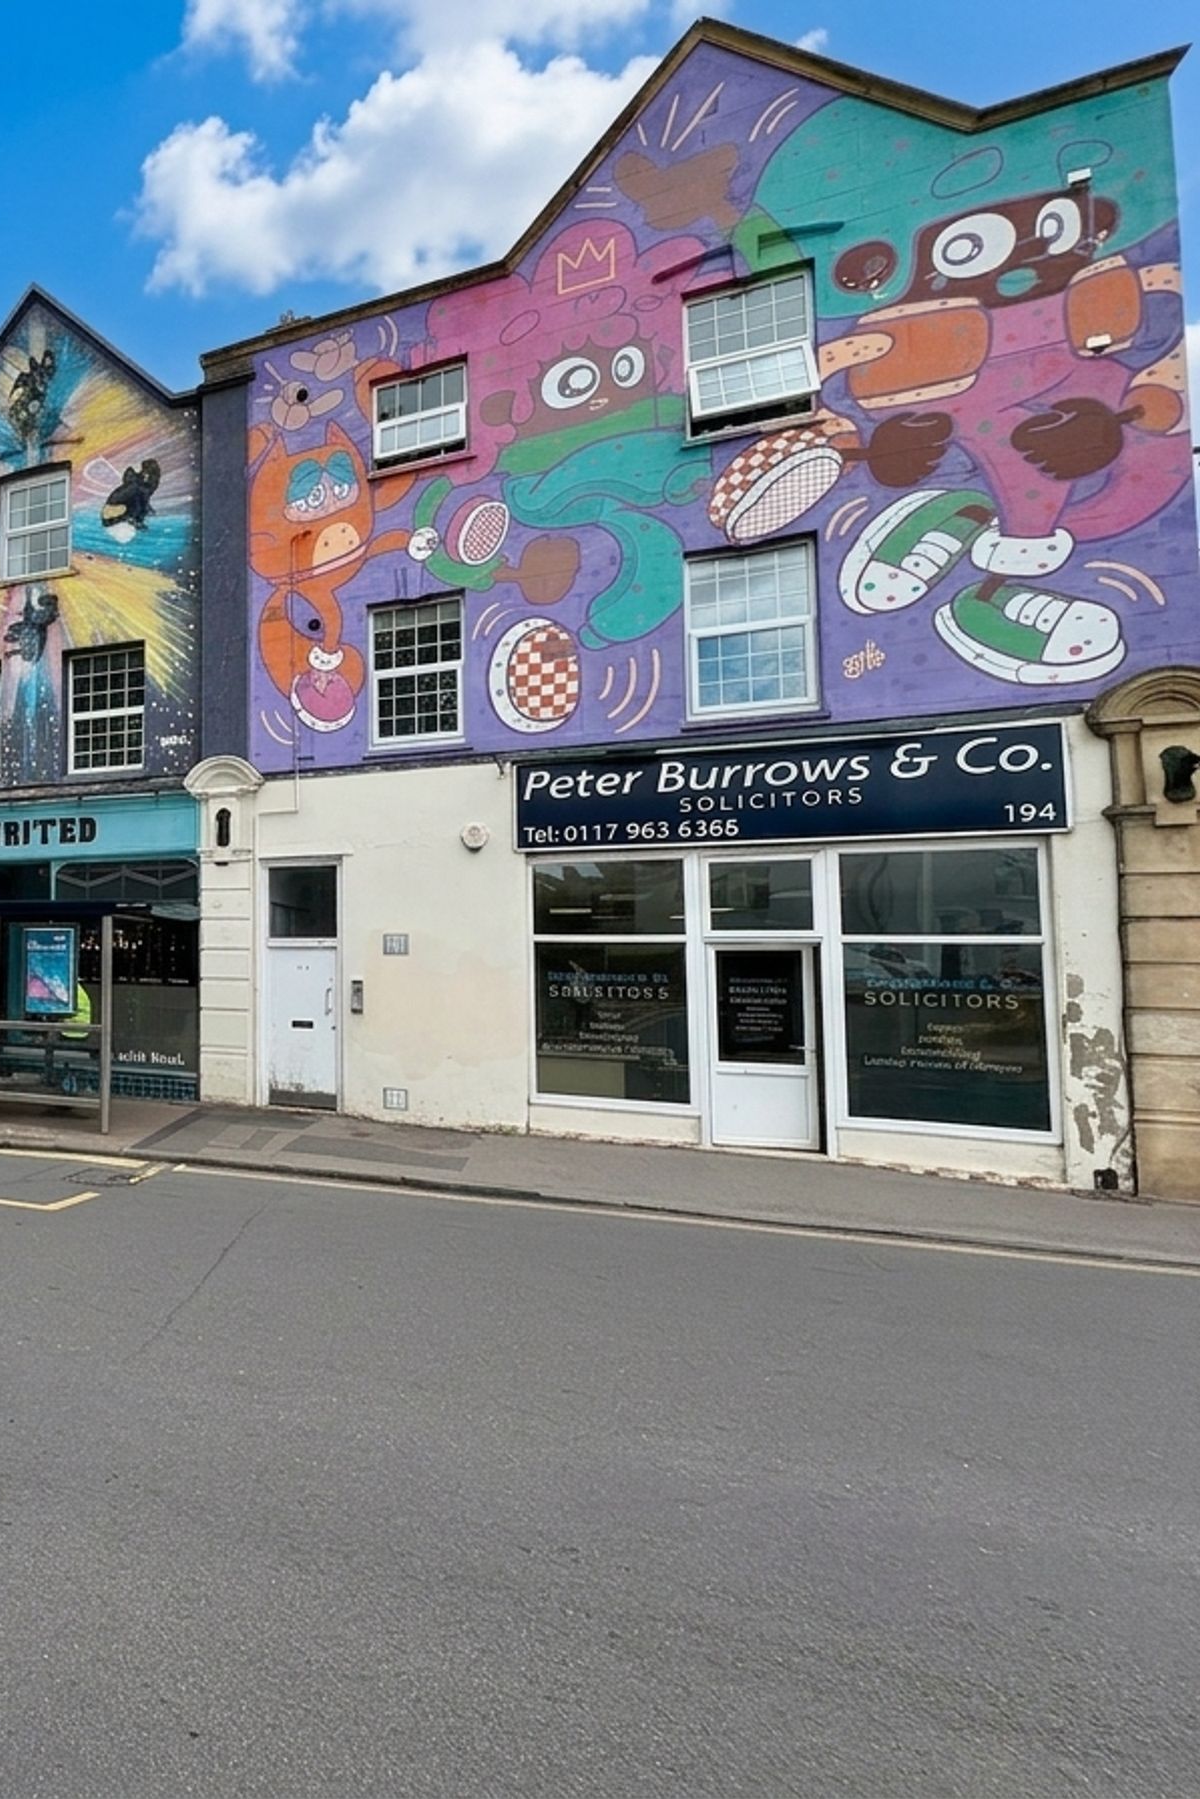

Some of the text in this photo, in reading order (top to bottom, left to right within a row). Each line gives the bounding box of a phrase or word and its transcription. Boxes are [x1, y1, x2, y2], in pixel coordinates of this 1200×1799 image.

[523, 736, 1053, 801] Peter Burrows & Co.
[679, 787, 862, 813] SOLICITORS
[1003, 802, 1057, 823] 194
[563, 823, 619, 842] 0117
[625, 821, 670, 841] 963
[863, 991, 1019, 1010] SOLICITORS
